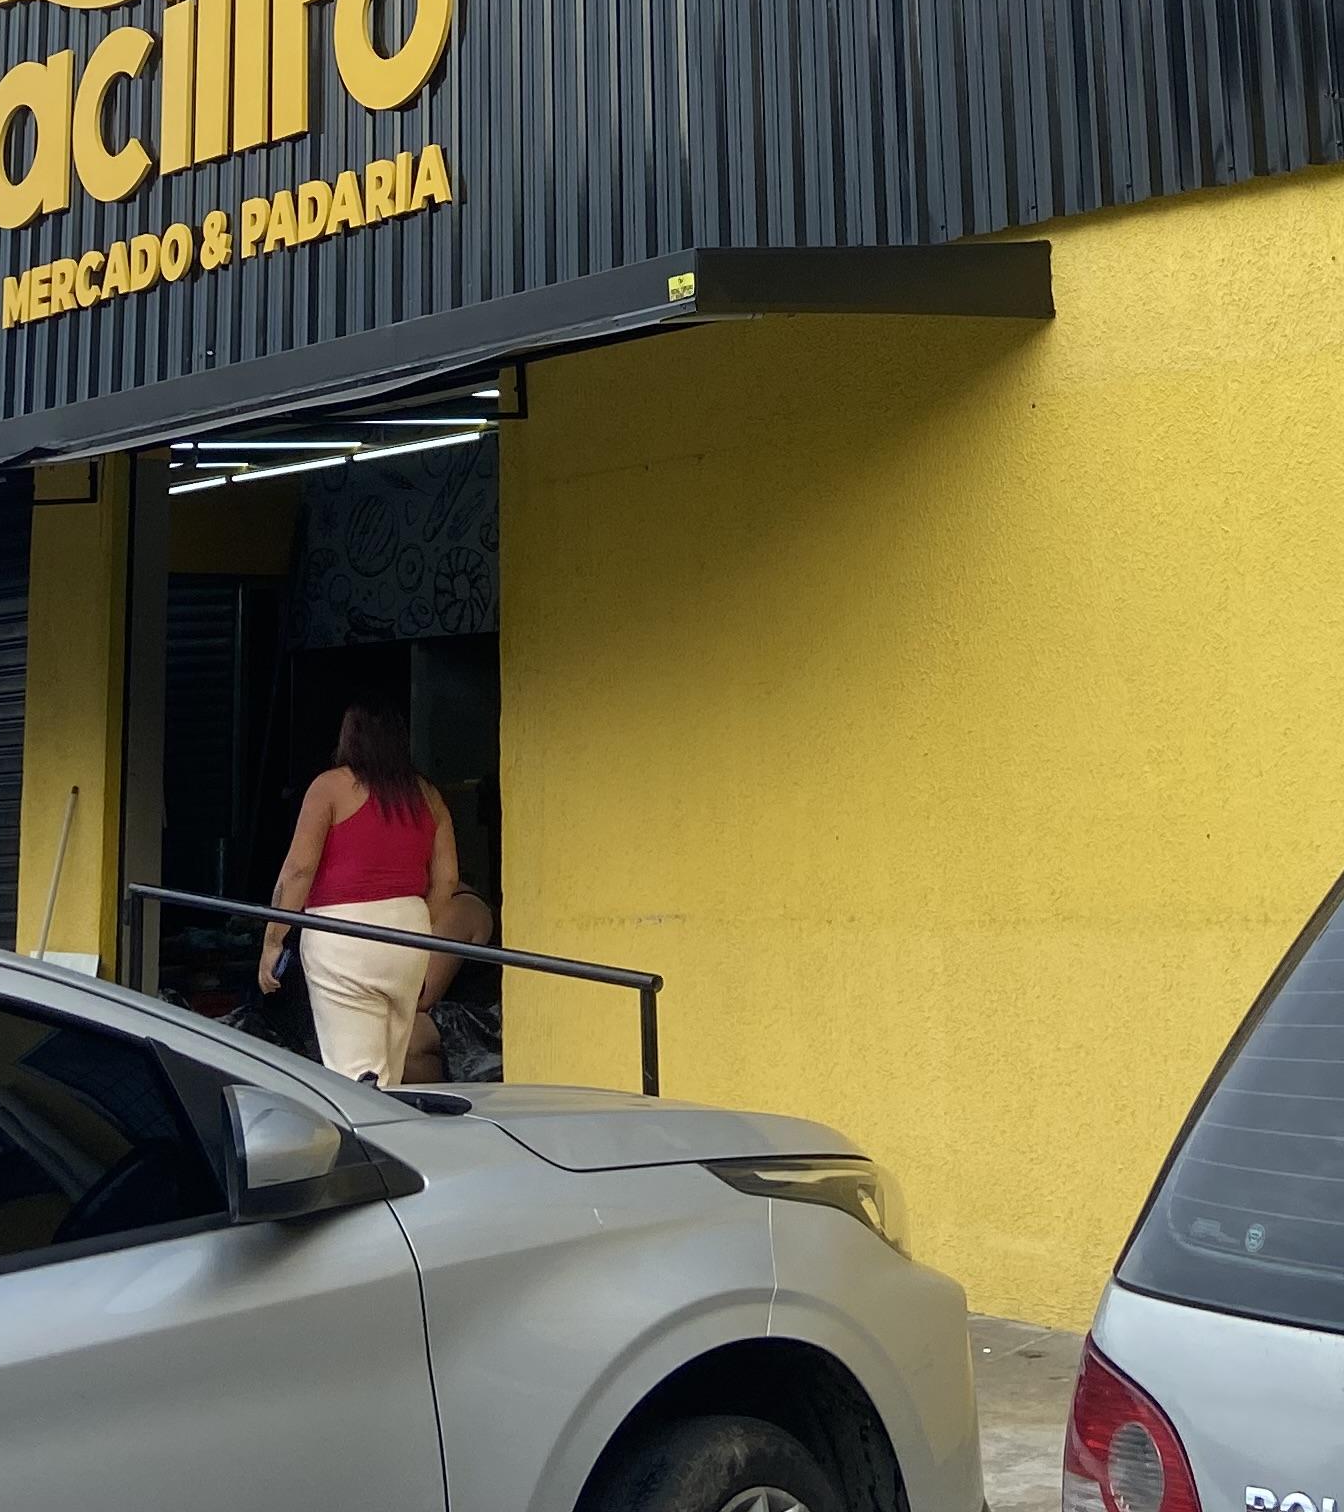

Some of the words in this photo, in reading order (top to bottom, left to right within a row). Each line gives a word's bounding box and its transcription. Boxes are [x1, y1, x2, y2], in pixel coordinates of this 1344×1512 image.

[1, 222, 195, 330] MERCADO
[200, 209, 233, 272] &
[240, 143, 454, 260] PADARIA
